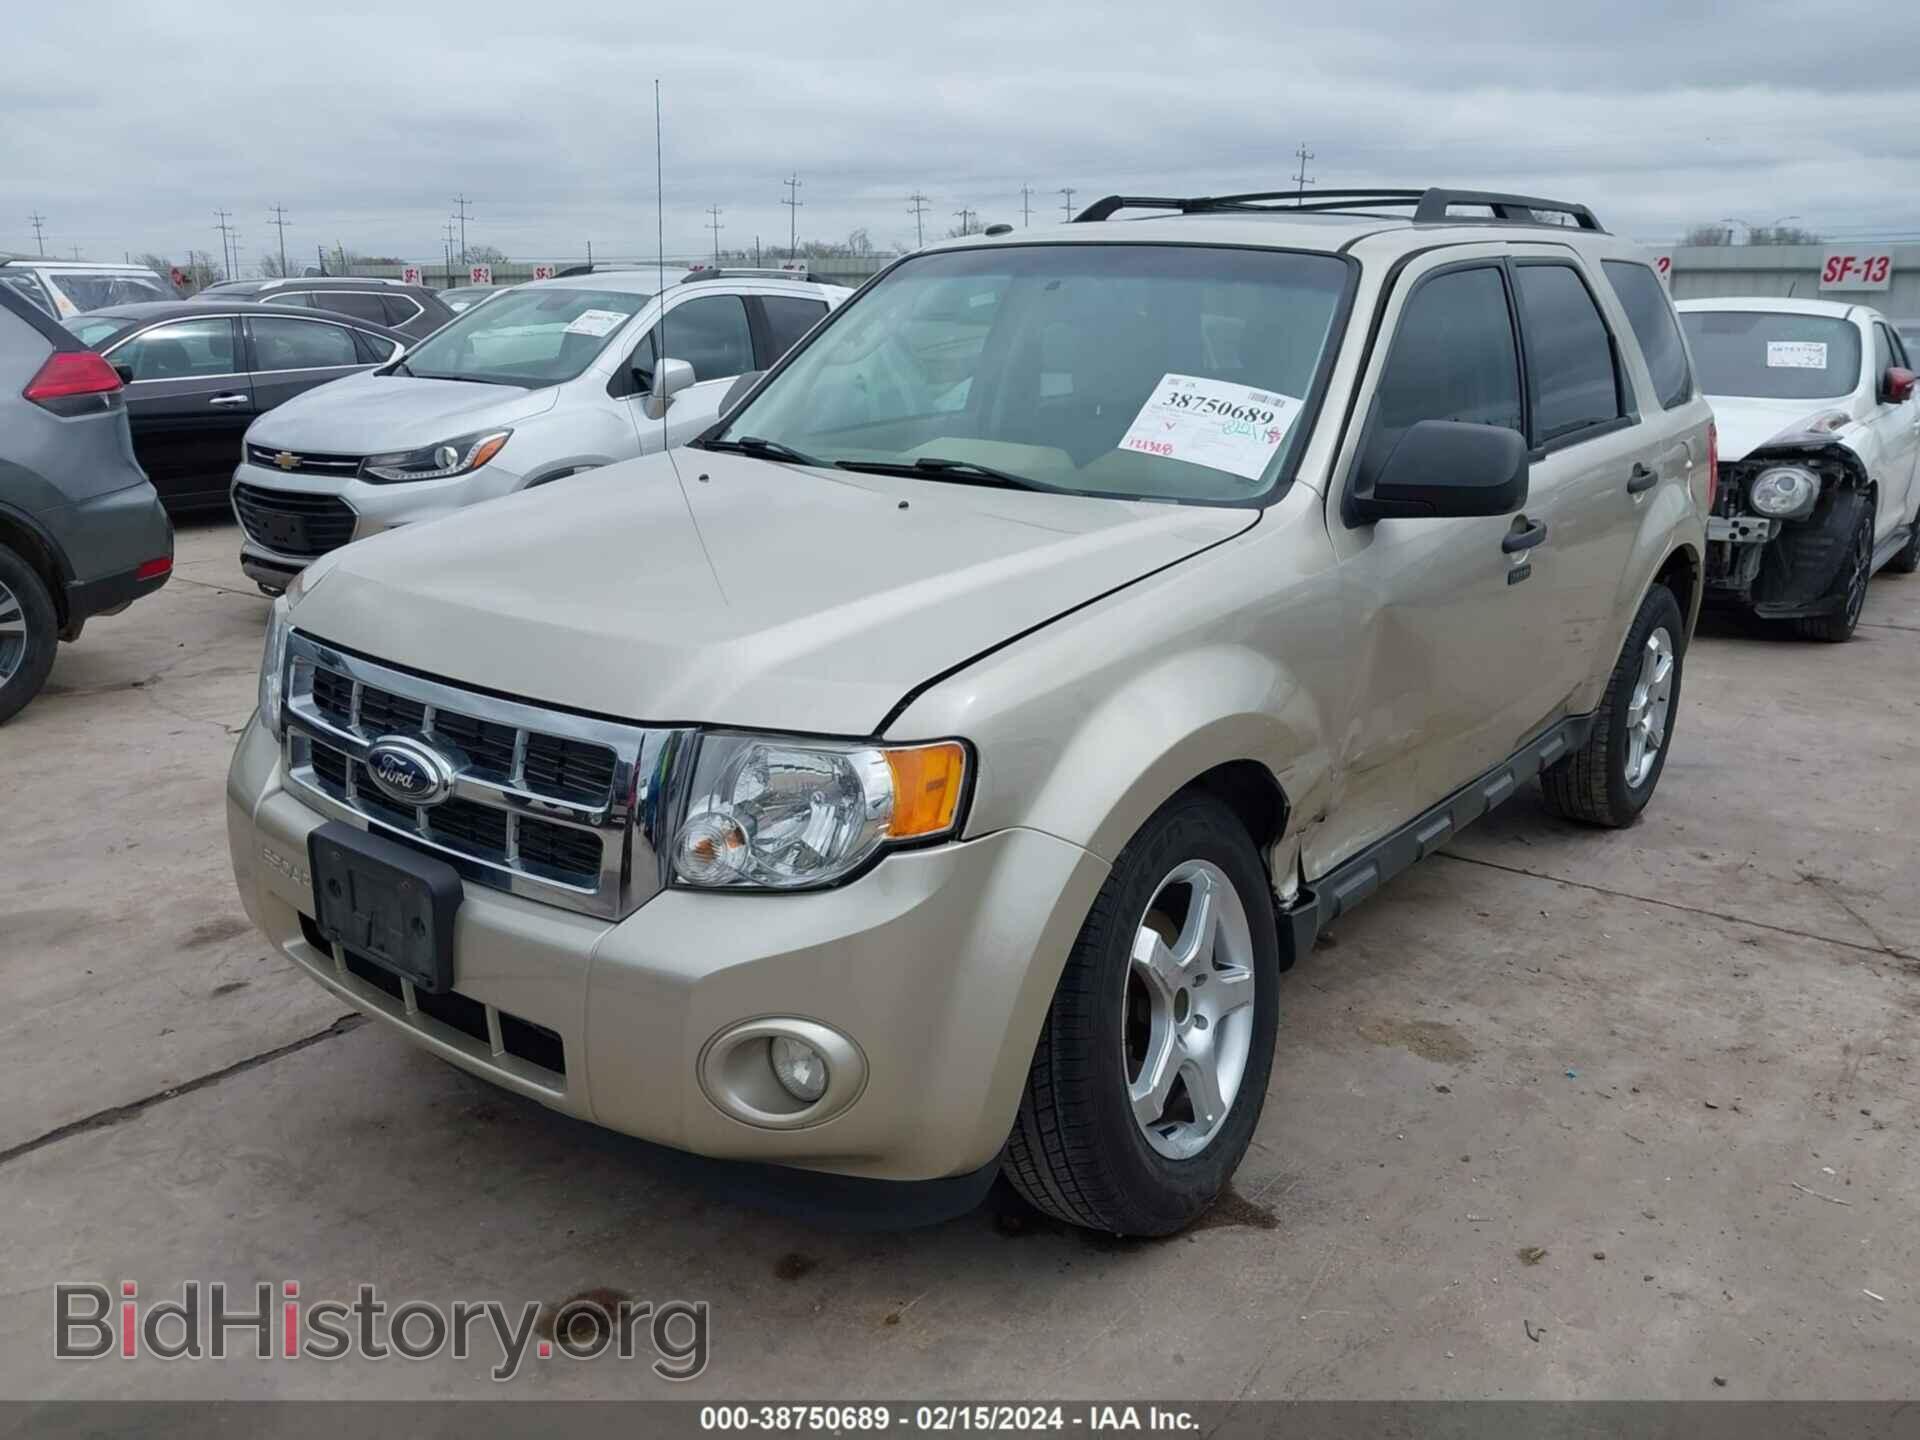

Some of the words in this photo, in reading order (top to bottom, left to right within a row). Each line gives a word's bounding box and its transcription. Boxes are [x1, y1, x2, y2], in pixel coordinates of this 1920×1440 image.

[473, 268, 489, 283] SF-2
[1822, 255, 1890, 282] SF-13
[1162, 391, 1275, 425] 38750689
[377, 753, 416, 789] Ford
